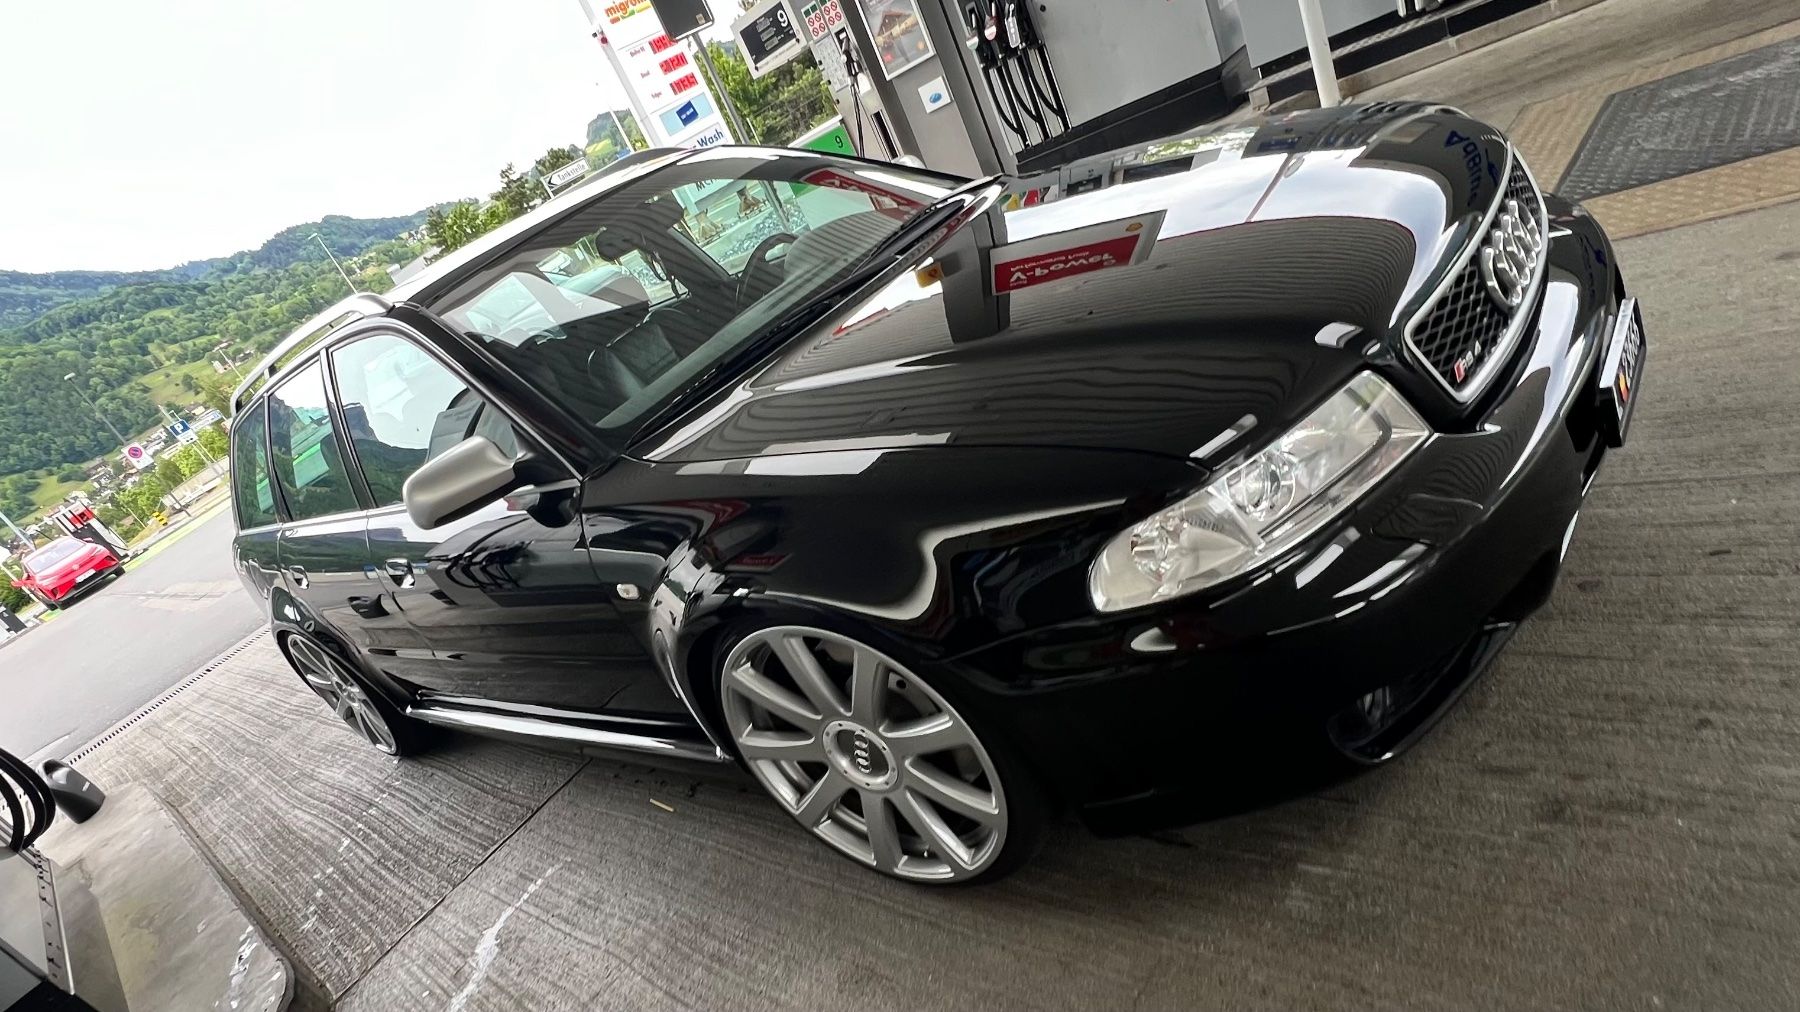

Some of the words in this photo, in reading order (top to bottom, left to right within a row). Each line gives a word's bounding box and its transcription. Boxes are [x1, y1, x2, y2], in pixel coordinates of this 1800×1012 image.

[777, 9, 789, 27] 9
[696, 128, 724, 147] Wash
[834, 134, 844, 149] 9
[557, 163, 586, 182] Tankstelle
[173, 422, 184, 434] P
